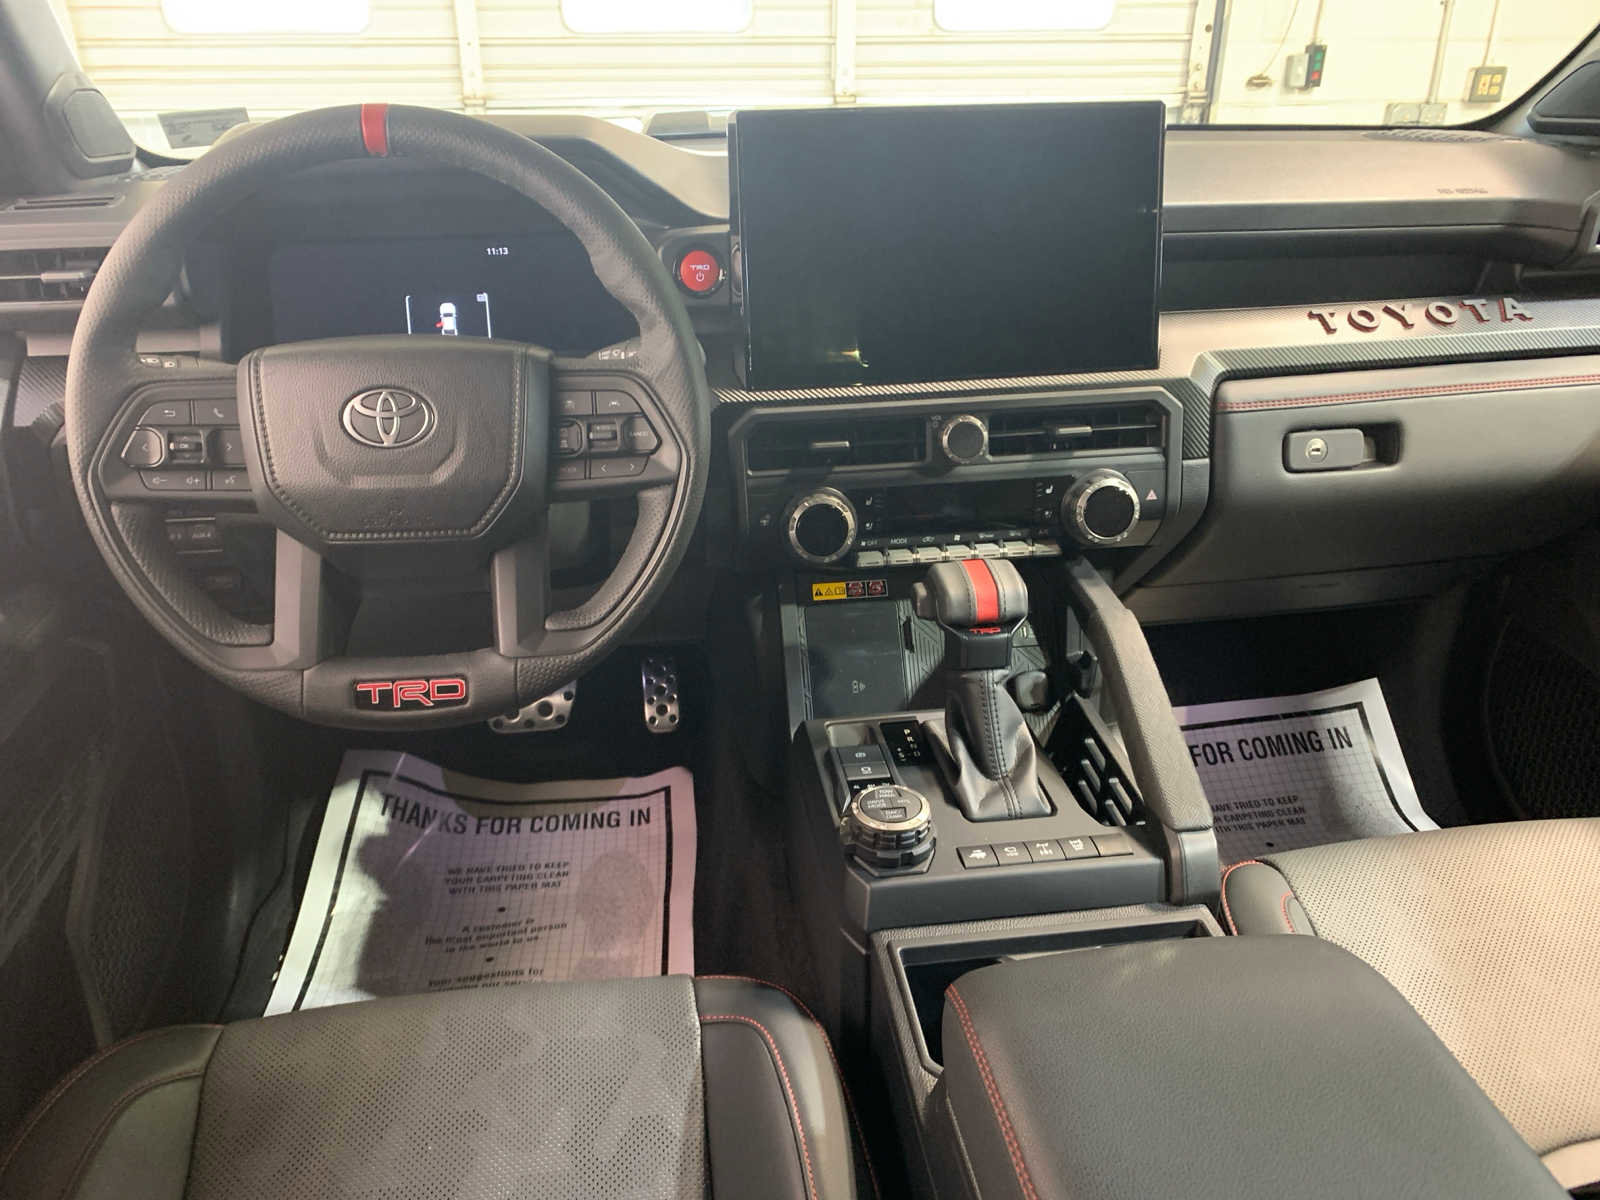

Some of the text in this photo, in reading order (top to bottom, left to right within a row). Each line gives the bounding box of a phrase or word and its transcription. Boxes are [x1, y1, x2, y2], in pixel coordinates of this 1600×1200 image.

[487, 247, 509, 256] 11:13
[1307, 297, 1533, 336] TOYOTA
[890, 537, 908, 545] MODE
[356, 678, 466, 708] TRD
[1188, 726, 1353, 767] FOR COMING IN
[379, 792, 651, 835] THANKS FOR COMING IN
